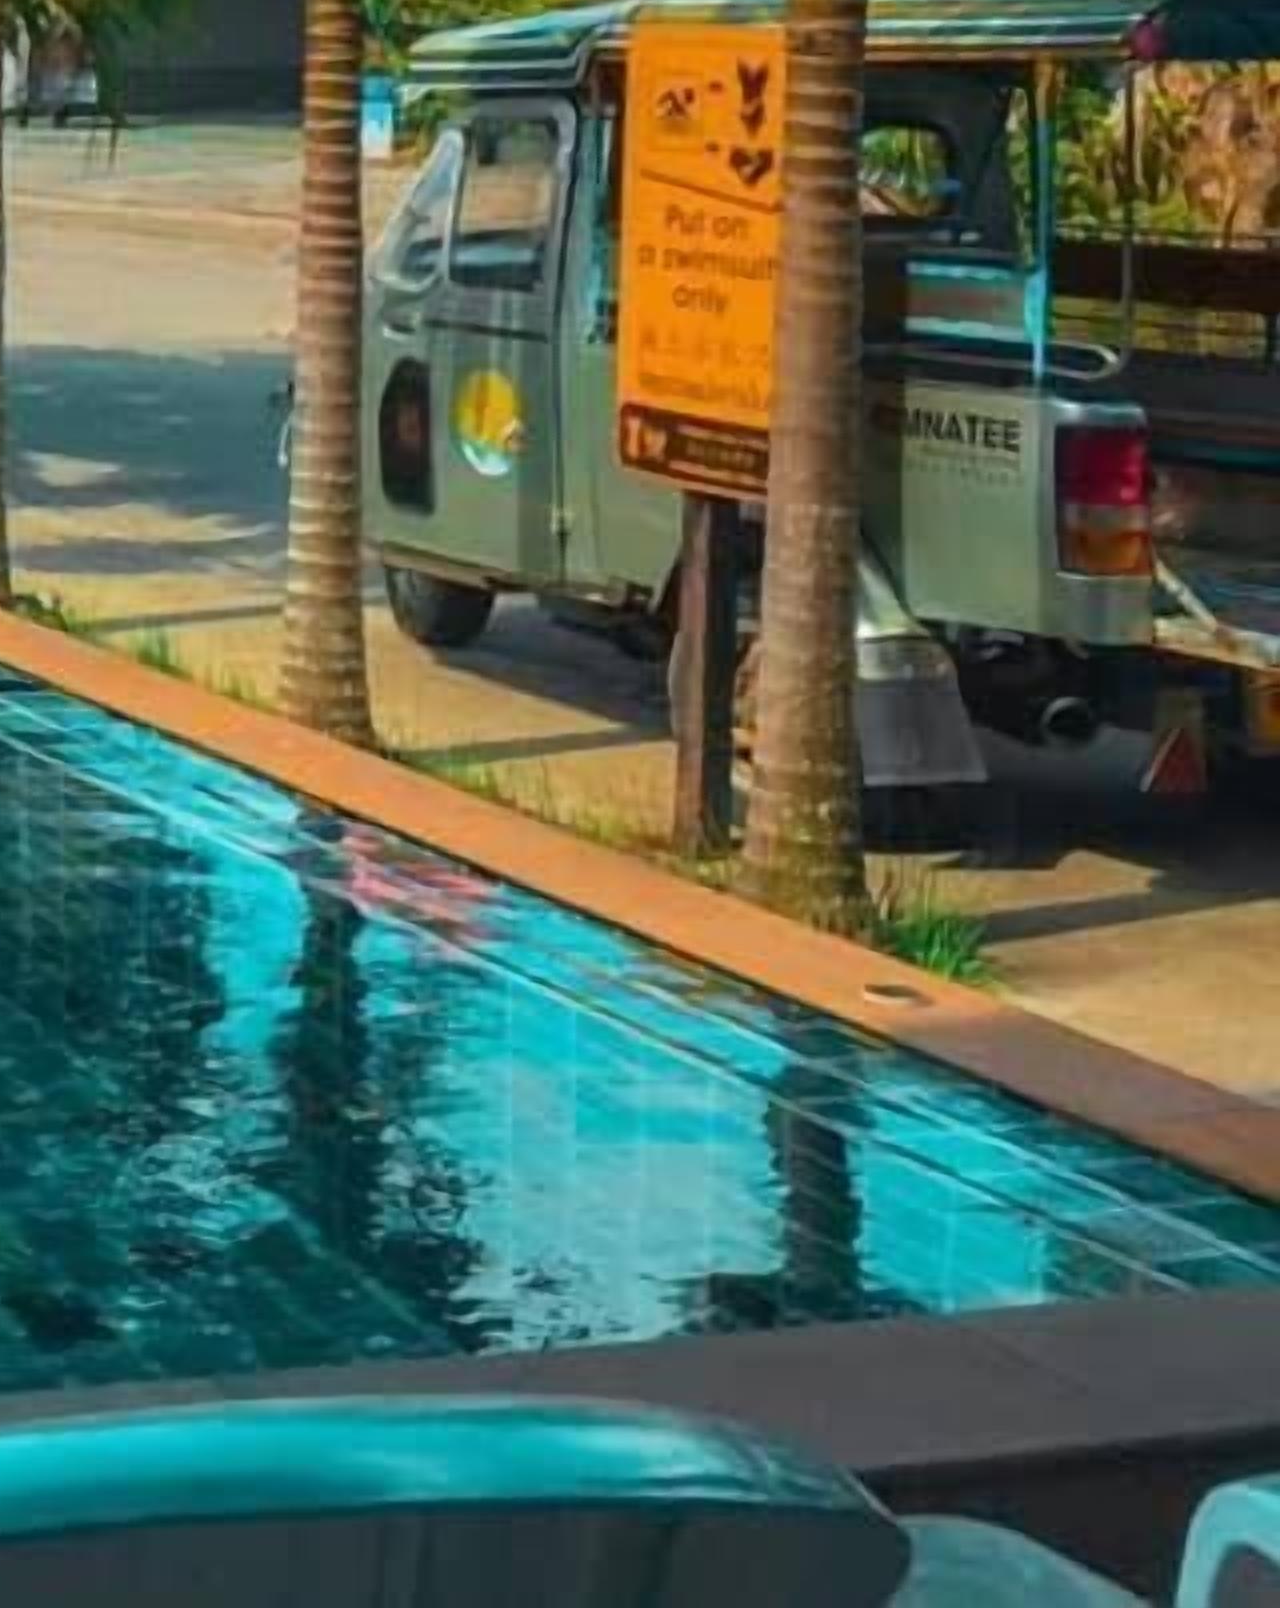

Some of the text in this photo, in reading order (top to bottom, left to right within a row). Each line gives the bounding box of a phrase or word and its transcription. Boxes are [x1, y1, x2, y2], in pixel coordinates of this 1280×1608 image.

[664, 203, 750, 240] Put on
[637, 244, 657, 266] a
[672, 284, 730, 319] only
